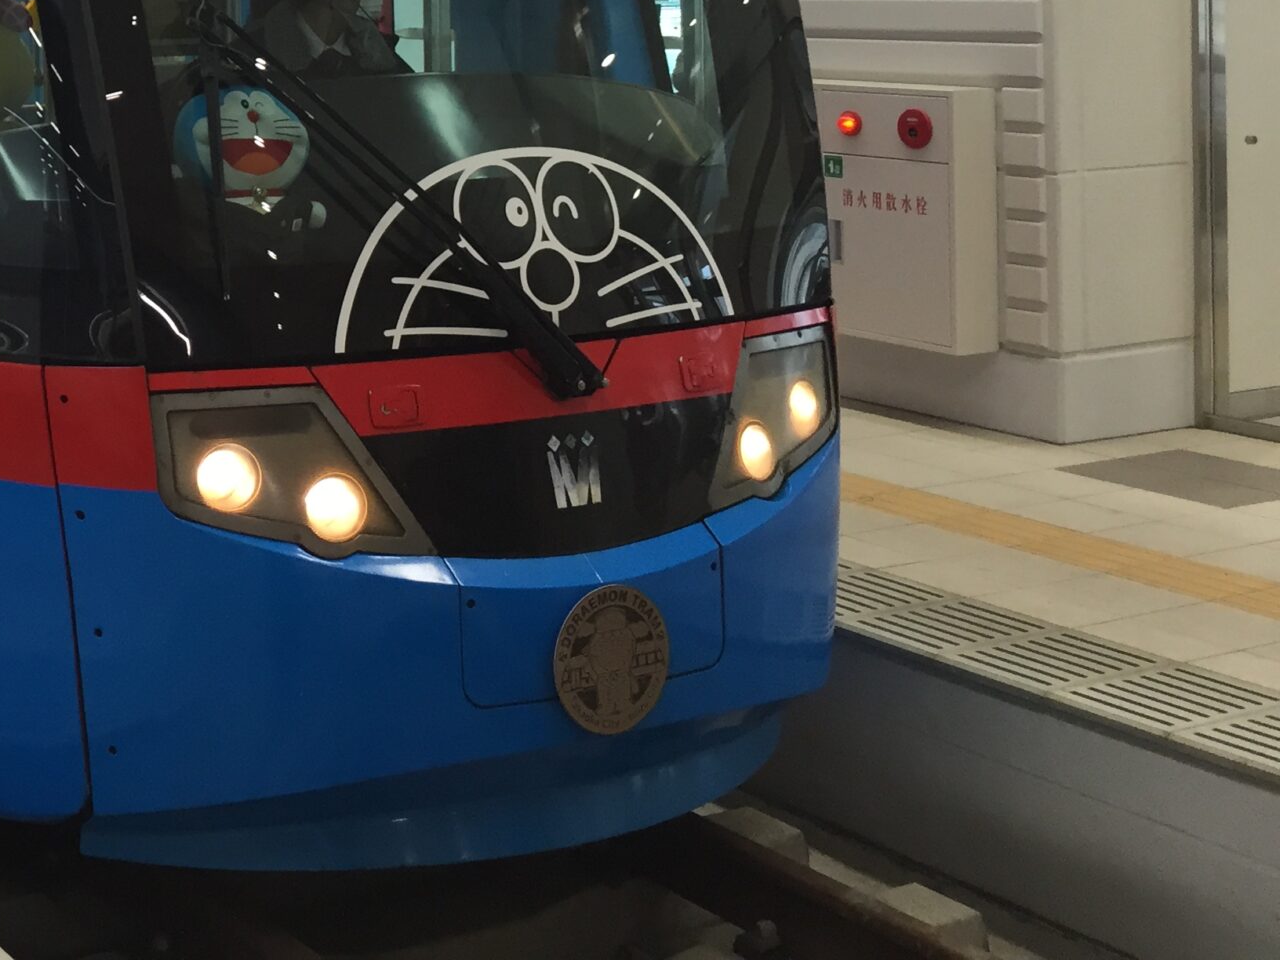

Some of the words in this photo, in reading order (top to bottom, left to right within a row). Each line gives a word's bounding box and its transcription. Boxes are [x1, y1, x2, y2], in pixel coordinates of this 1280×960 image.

[842, 188, 928, 216] 消火用散水栓
[560, 589, 629, 649] DORAEMON
